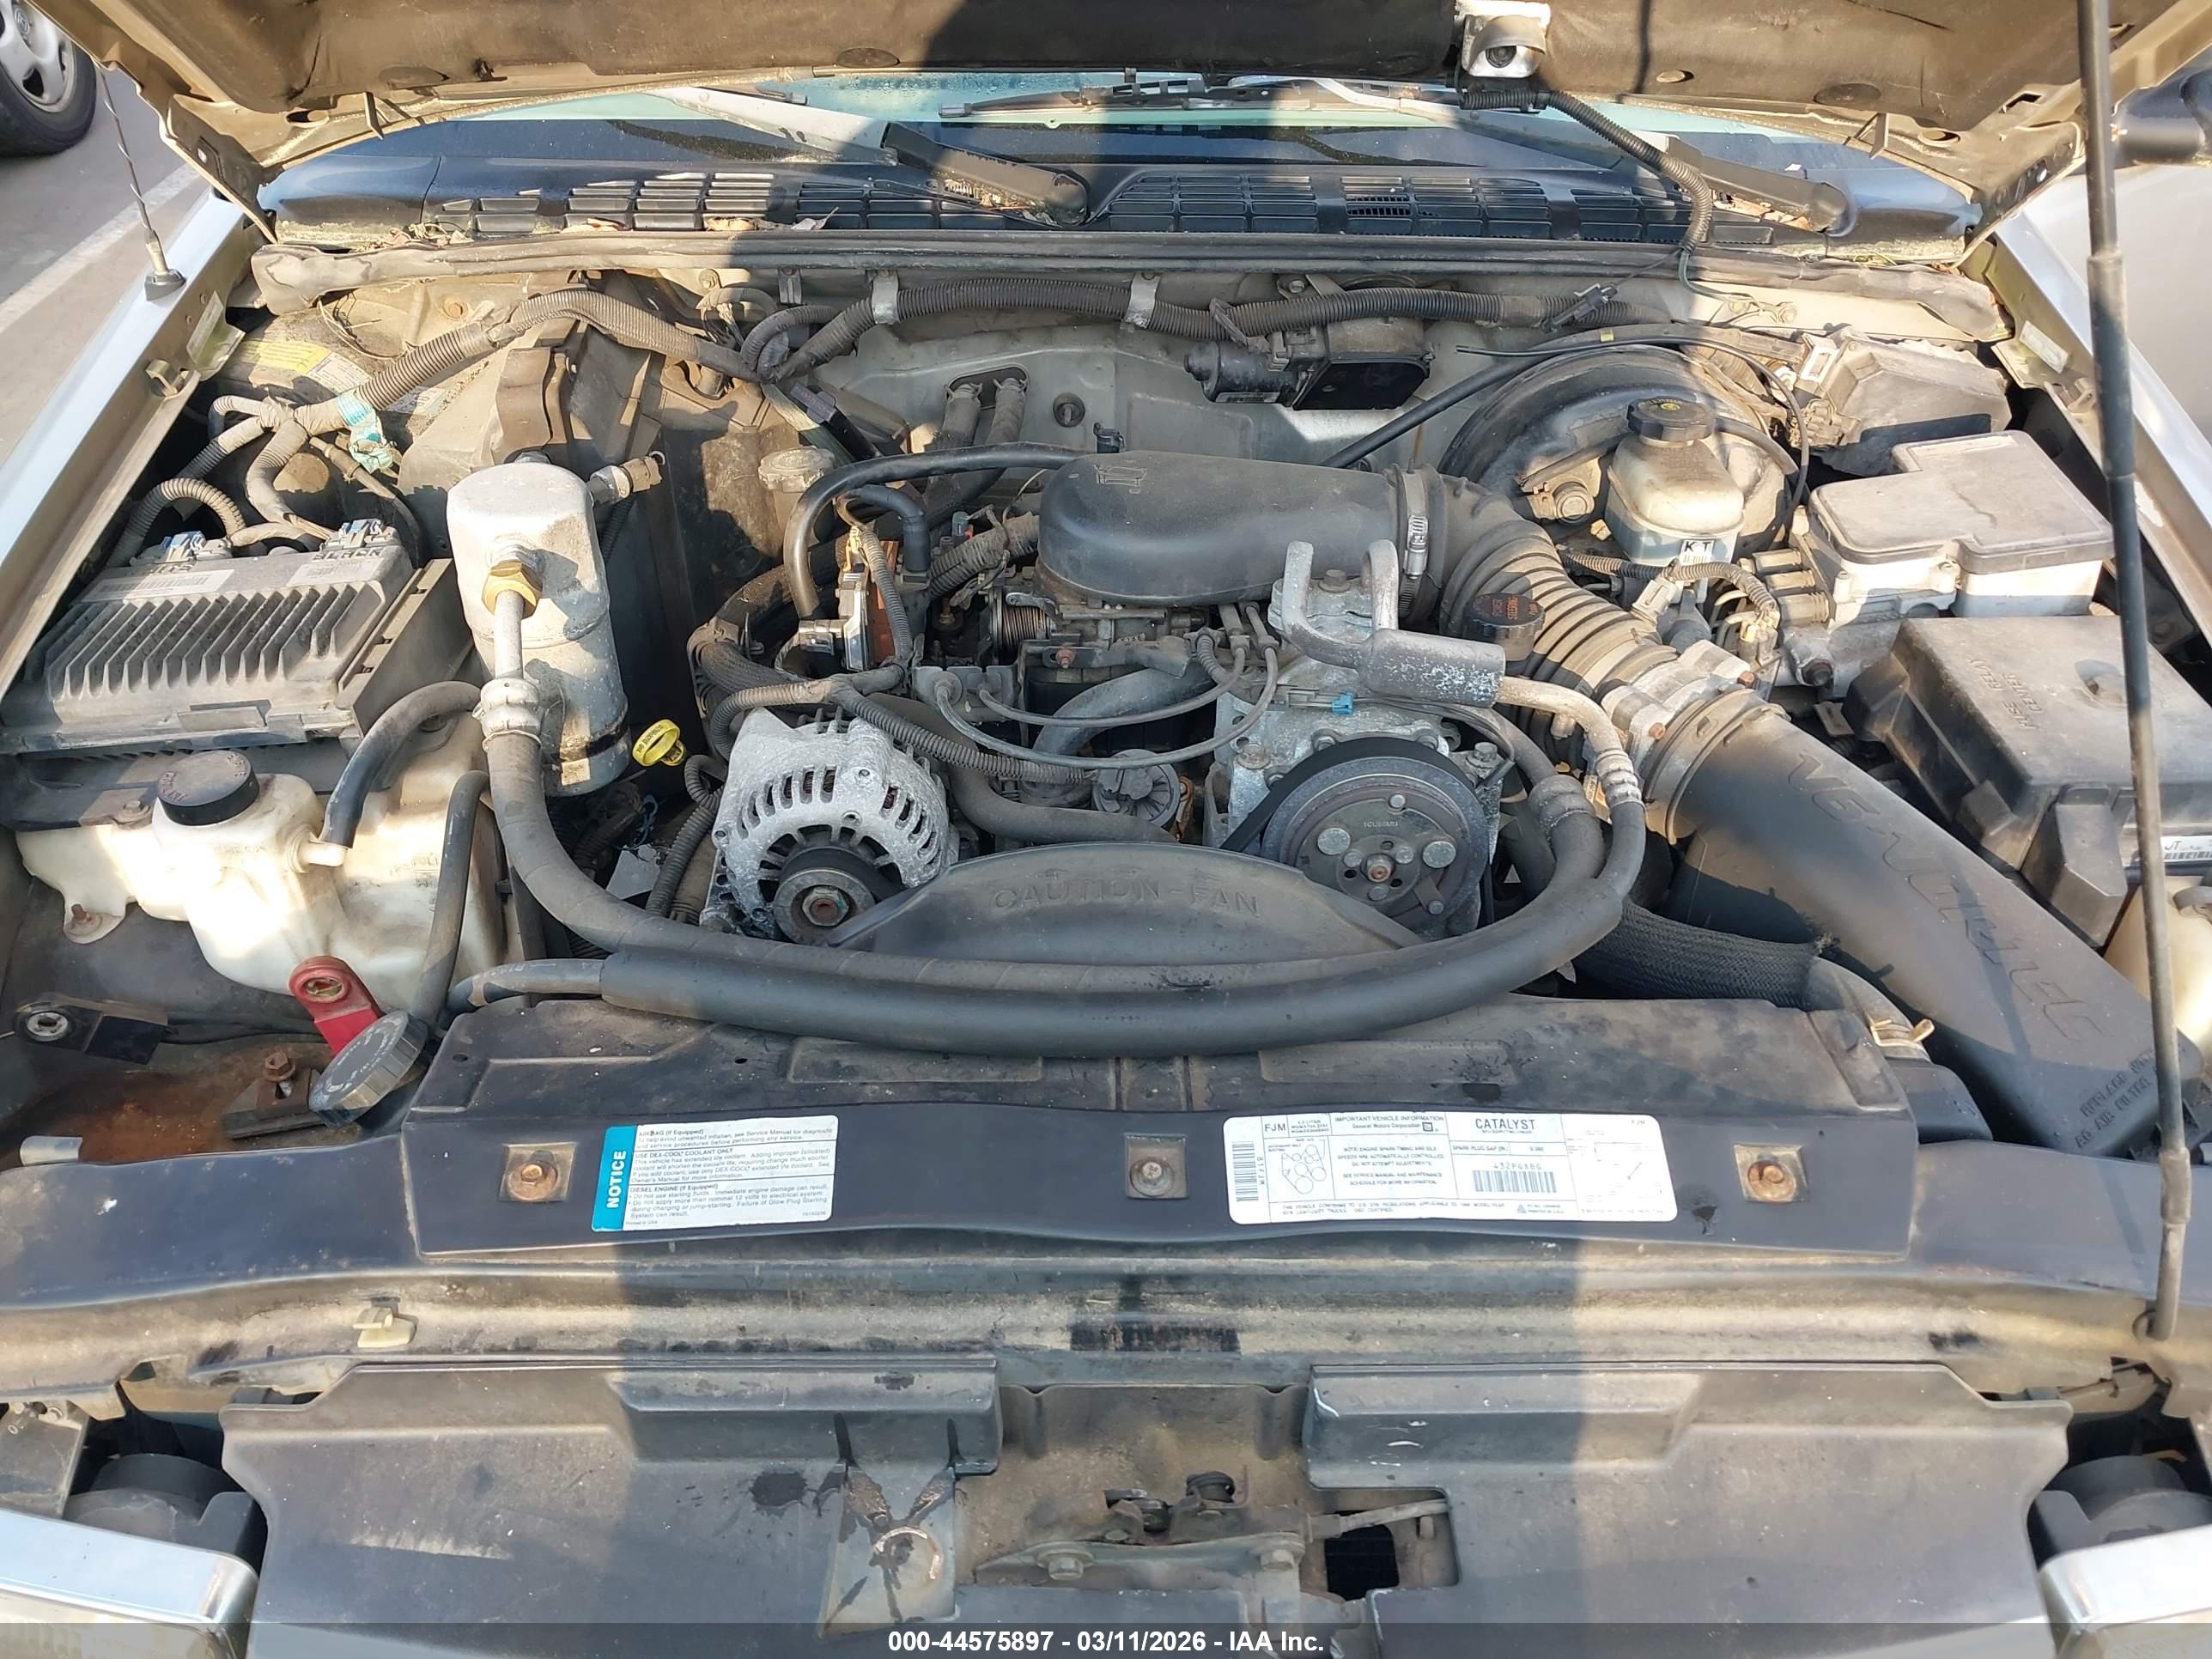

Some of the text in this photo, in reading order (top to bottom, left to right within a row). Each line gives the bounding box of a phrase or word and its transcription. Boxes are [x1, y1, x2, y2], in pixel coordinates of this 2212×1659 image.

[992, 879, 1260, 918] CAUTION FAN
[2080, 1072, 2126, 1117] REPLACE
[1265, 1123, 1286, 1132] FJM
[1475, 1119, 1535, 1131] CATALYST
[2094, 1111, 2115, 1130] AIR
[606, 1150, 627, 1209] NOTICE
